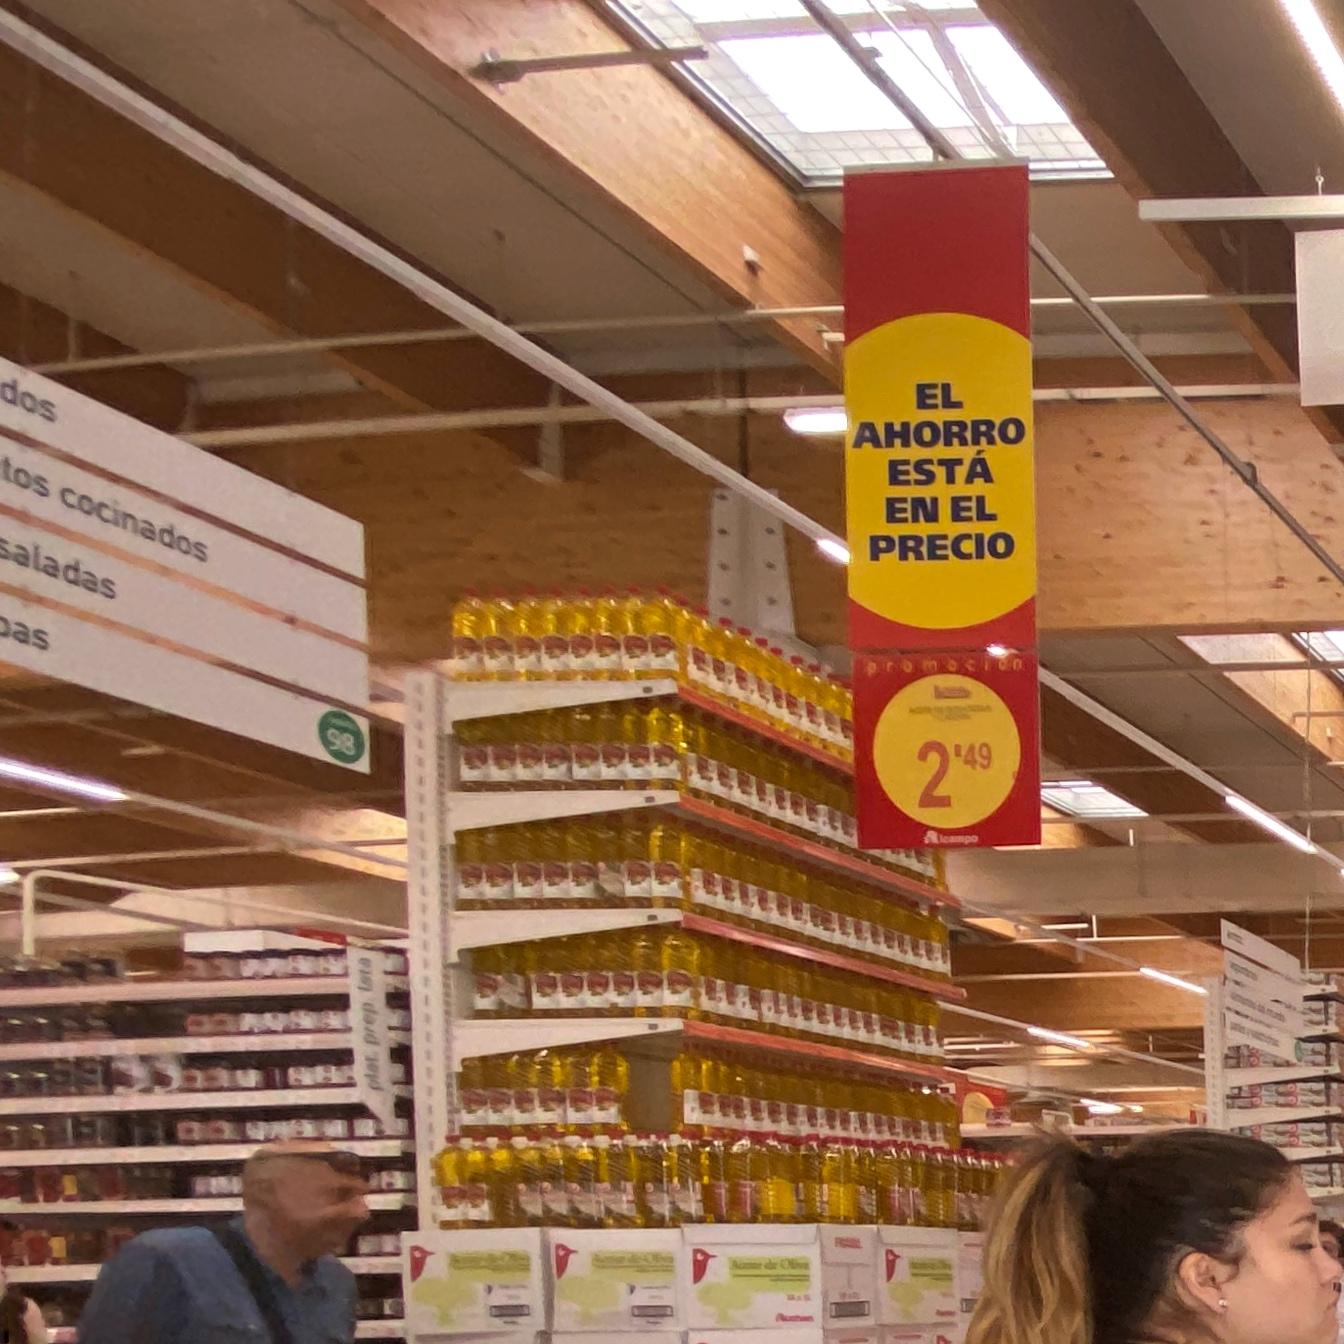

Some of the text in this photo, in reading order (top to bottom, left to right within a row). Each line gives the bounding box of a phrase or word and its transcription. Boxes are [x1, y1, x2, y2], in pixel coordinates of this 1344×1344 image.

[916, 383, 964, 410] EL
[852, 417, 1026, 449] AHORRO
[888, 450, 994, 486] ESTÁ
[60, 483, 209, 563] cocinados
[886, 495, 998, 524] EN EL
[869, 531, 1016, 562] PRECIO
[326, 726, 356, 757] 98
